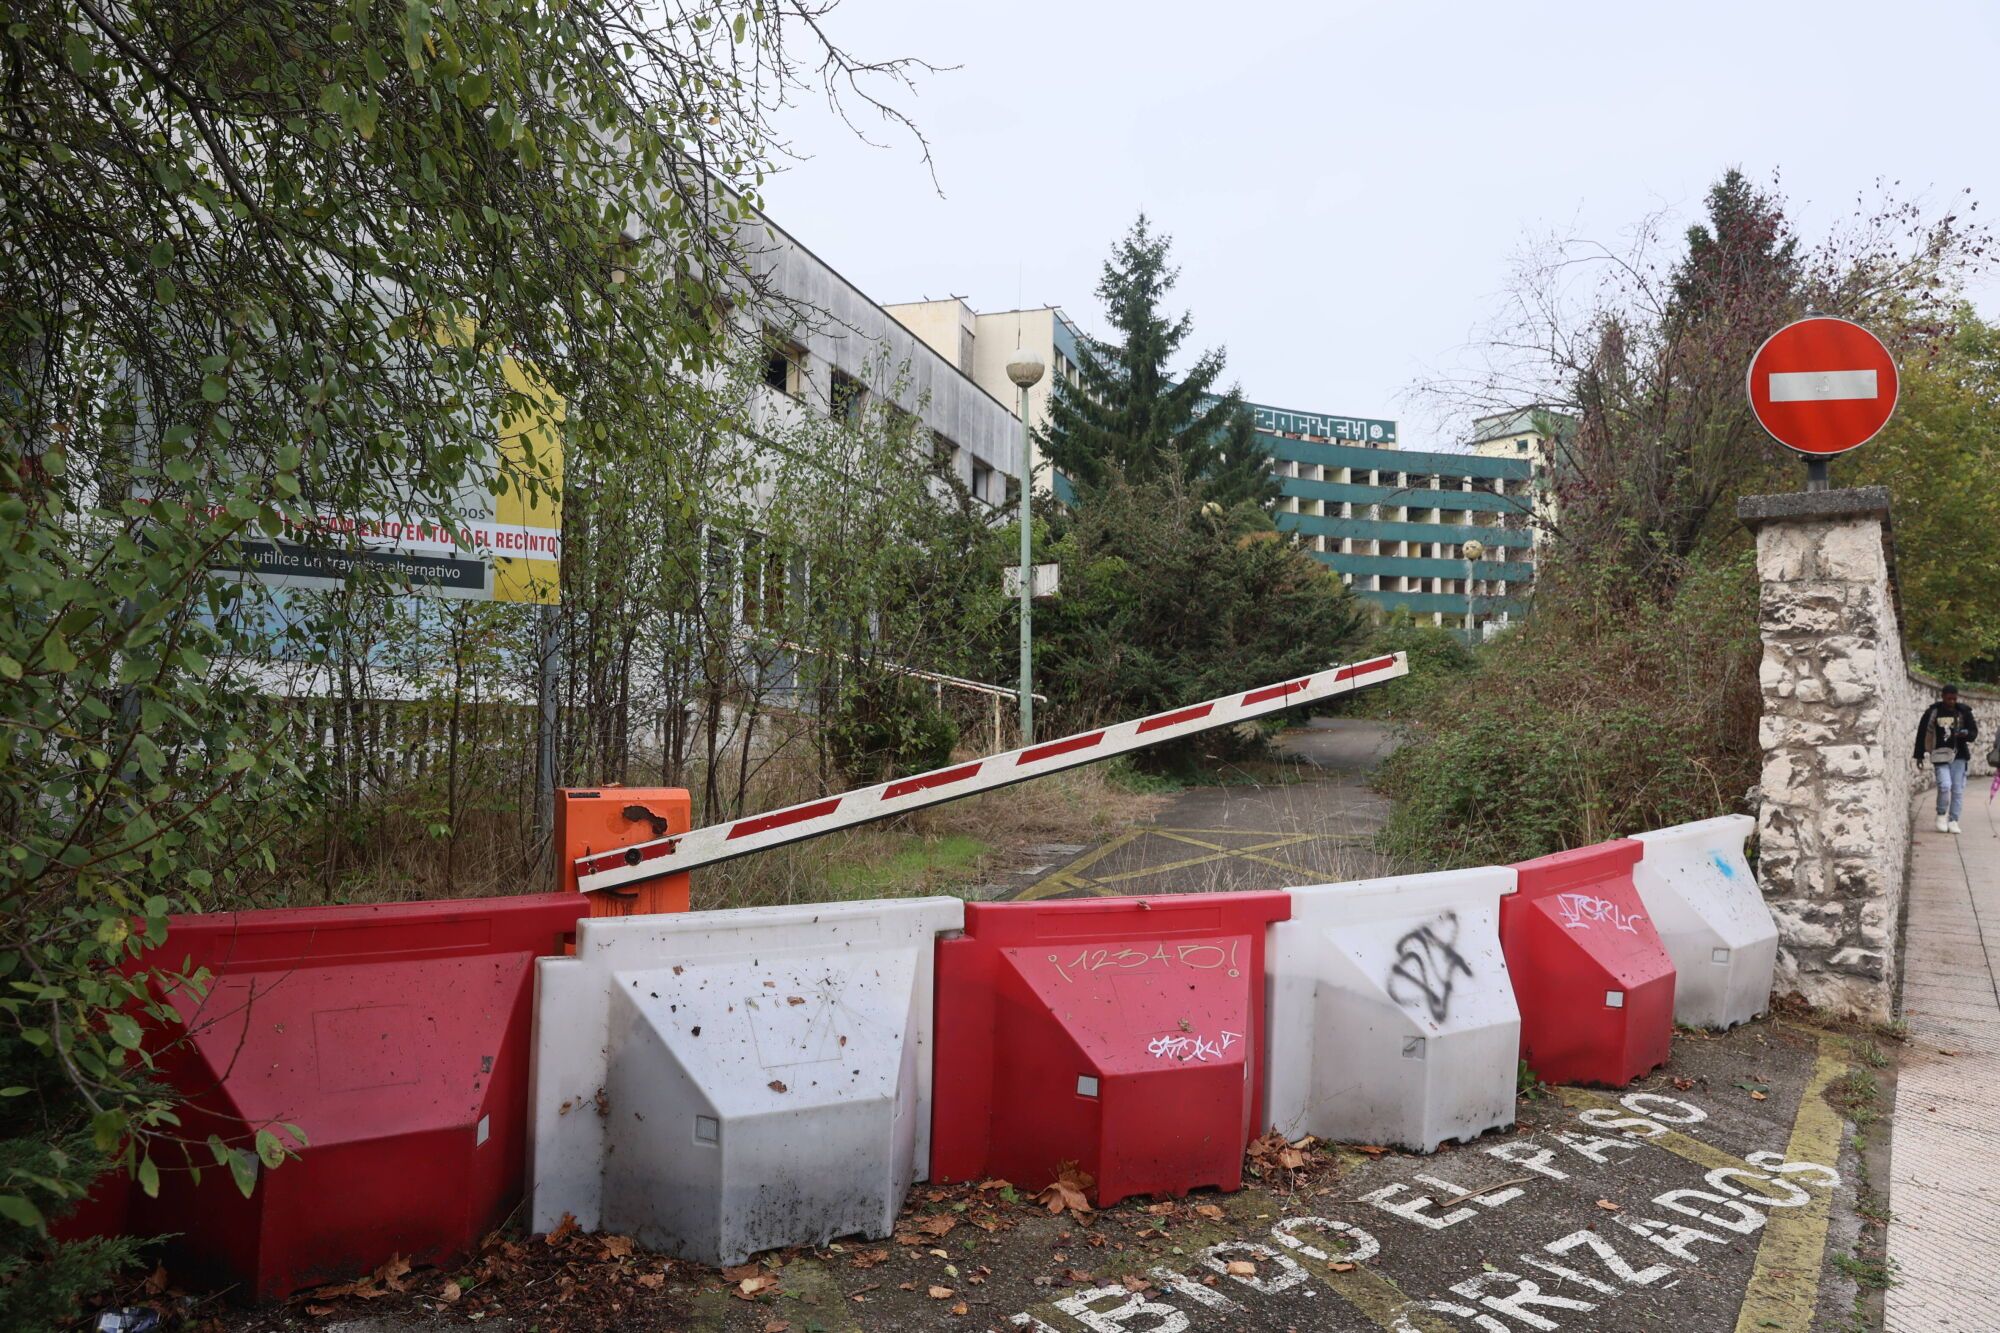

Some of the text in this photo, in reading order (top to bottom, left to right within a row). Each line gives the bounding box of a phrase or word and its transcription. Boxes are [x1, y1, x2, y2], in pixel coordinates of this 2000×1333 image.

[407, 524, 426, 541] EN
[475, 530, 491, 547] EL
[496, 532, 556, 552] RECINTO
[254, 551, 300, 567] utilice
[389, 560, 461, 579] alternativo
[1360, 1174, 1526, 1230] EL
[1484, 1093, 1708, 1180] PASO
